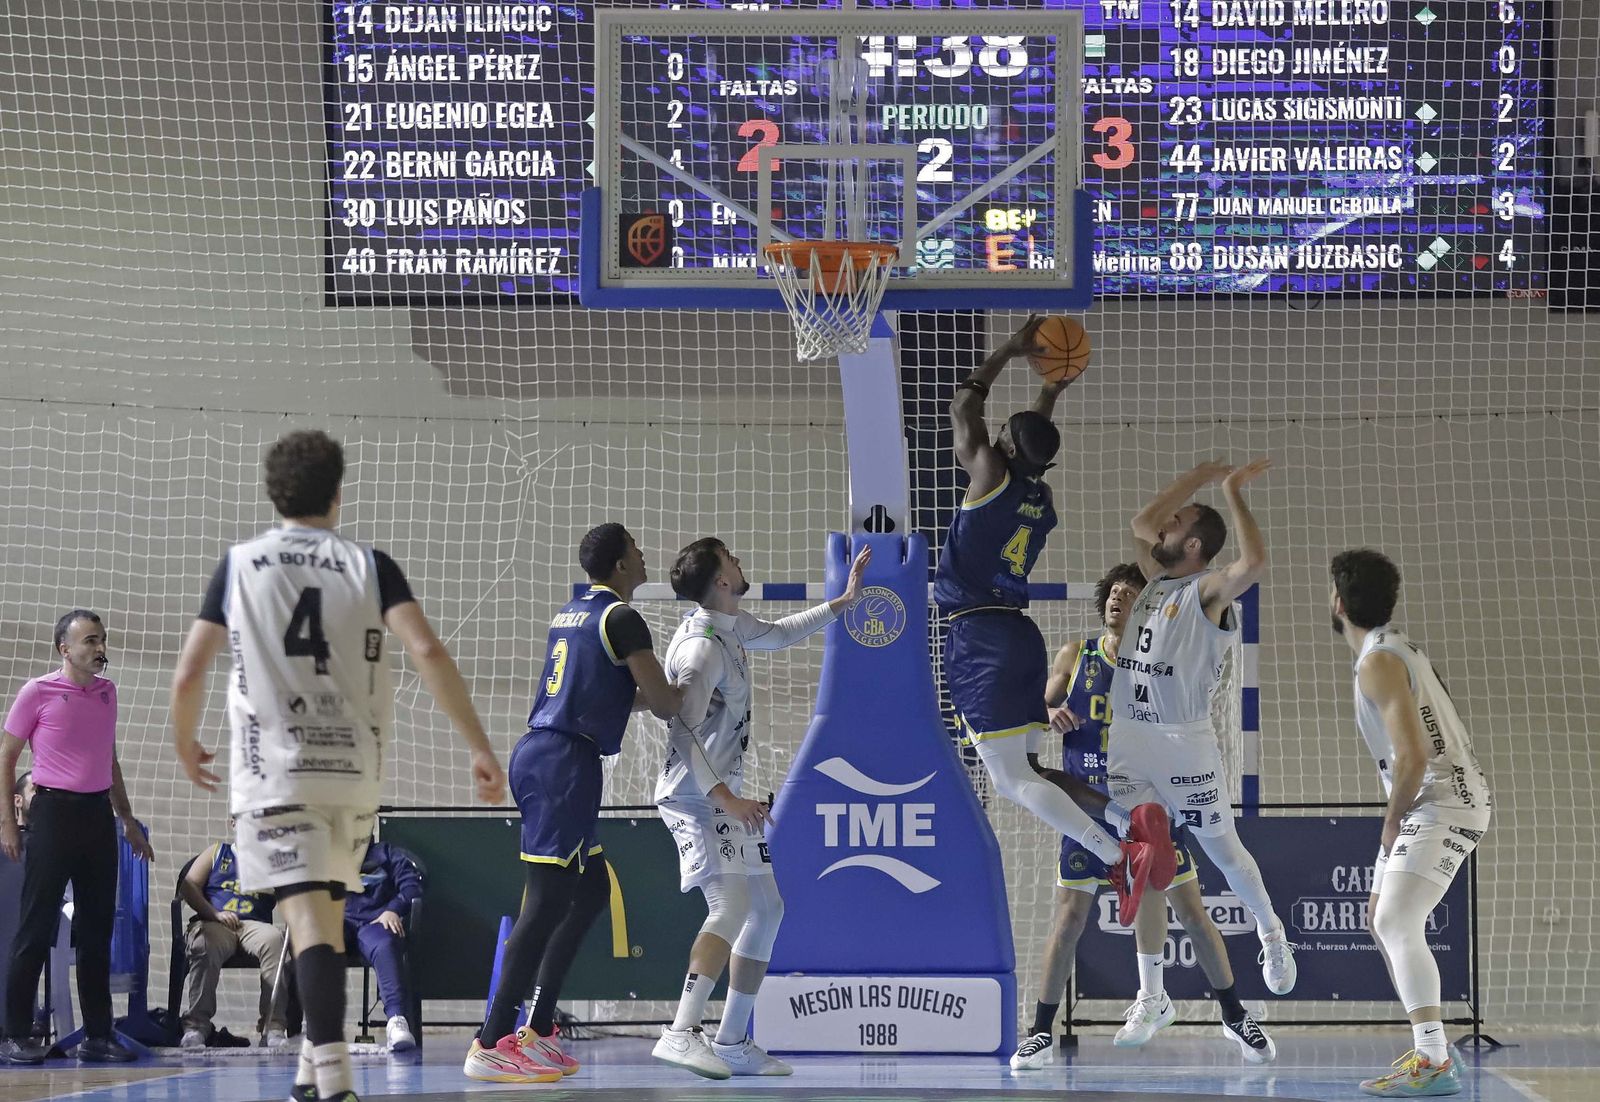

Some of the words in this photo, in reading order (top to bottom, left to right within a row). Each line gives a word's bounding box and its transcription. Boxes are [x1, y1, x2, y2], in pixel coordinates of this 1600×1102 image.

[343, 6, 373, 35] 14
[385, 6, 457, 33] DEJAN
[465, 5, 552, 32] ILINCIC
[1100, 0, 1140, 19] TM
[1170, 0, 1199, 28] 14
[1212, 0, 1285, 27] DAVID
[1293, 0, 1388, 26] MELERO
[344, 54, 373, 83] 15
[385, 49, 461, 81] ÁNGEL
[468, 48, 541, 81] PÉREZ
[667, 53, 684, 81] 0
[1170, 48, 1199, 77] 18
[1212, 48, 1285, 75] DIEGO
[1292, 41, 1389, 74] JIMÉNEZ
[1499, 46, 1515, 74] 0
[720, 80, 797, 96] FALTAS
[345, 103, 372, 131] 21
[386, 102, 488, 130] EUGENIO
[496, 102, 554, 129] EGEA
[667, 99, 684, 128] 2
[883, 104, 988, 130] PERIODO
[1169, 96, 1202, 125] 23
[1212, 97, 1277, 121] LUCAS
[1283, 96, 1402, 121] SIGISMONTI
[1498, 94, 1515, 123] 2
[737, 120, 780, 172] 2
[1092, 116, 1135, 169] 3
[343, 150, 376, 182] 22
[386, 151, 457, 178] BERNI
[465, 150, 556, 177] GARCIA
[916, 138, 953, 182] 2
[1169, 144, 1203, 173] 44
[1211, 147, 1287, 172] JAVIER
[1294, 146, 1402, 176] VALEIRAS
[1498, 142, 1515, 171] 2
[343, 198, 376, 227] 30
[386, 199, 439, 226] LUIS
[446, 193, 527, 225] PAÑOS
[668, 199, 684, 228] 0
[1171, 192, 1199, 222] 77
[1211, 197, 1252, 215] JUAN
[1258, 197, 1325, 215] MANUEL
[1330, 196, 1401, 215] CEBOLLA
[1499, 192, 1515, 221] 3
[342, 247, 376, 275] 40
[386, 248, 447, 275] FRAN
[456, 242, 561, 275] RAMÍREZ
[1093, 250, 1161, 272] Medina
[1169, 242, 1203, 271] 88
[1213, 245, 1288, 270] DUSAN
[1296, 244, 1402, 270] JUZBASIC
[1498, 239, 1516, 268] 4
[1001, 524, 1033, 578] 4
[283, 586, 331, 676] 4
[850, 629, 899, 646] ALGECIRAS
[546, 638, 569, 697] 3
[1420, 705, 1445, 757] RUSTER
[1170, 771, 1216, 785] OEDIM
[815, 803, 936, 848] TME
[1316, 941, 1348, 951] Fuerzas
[789, 982, 853, 1019] MESÓN
[859, 984, 892, 1008] LAS
[897, 985, 967, 1019] DUELAS
[858, 1023, 898, 1046] 1988
